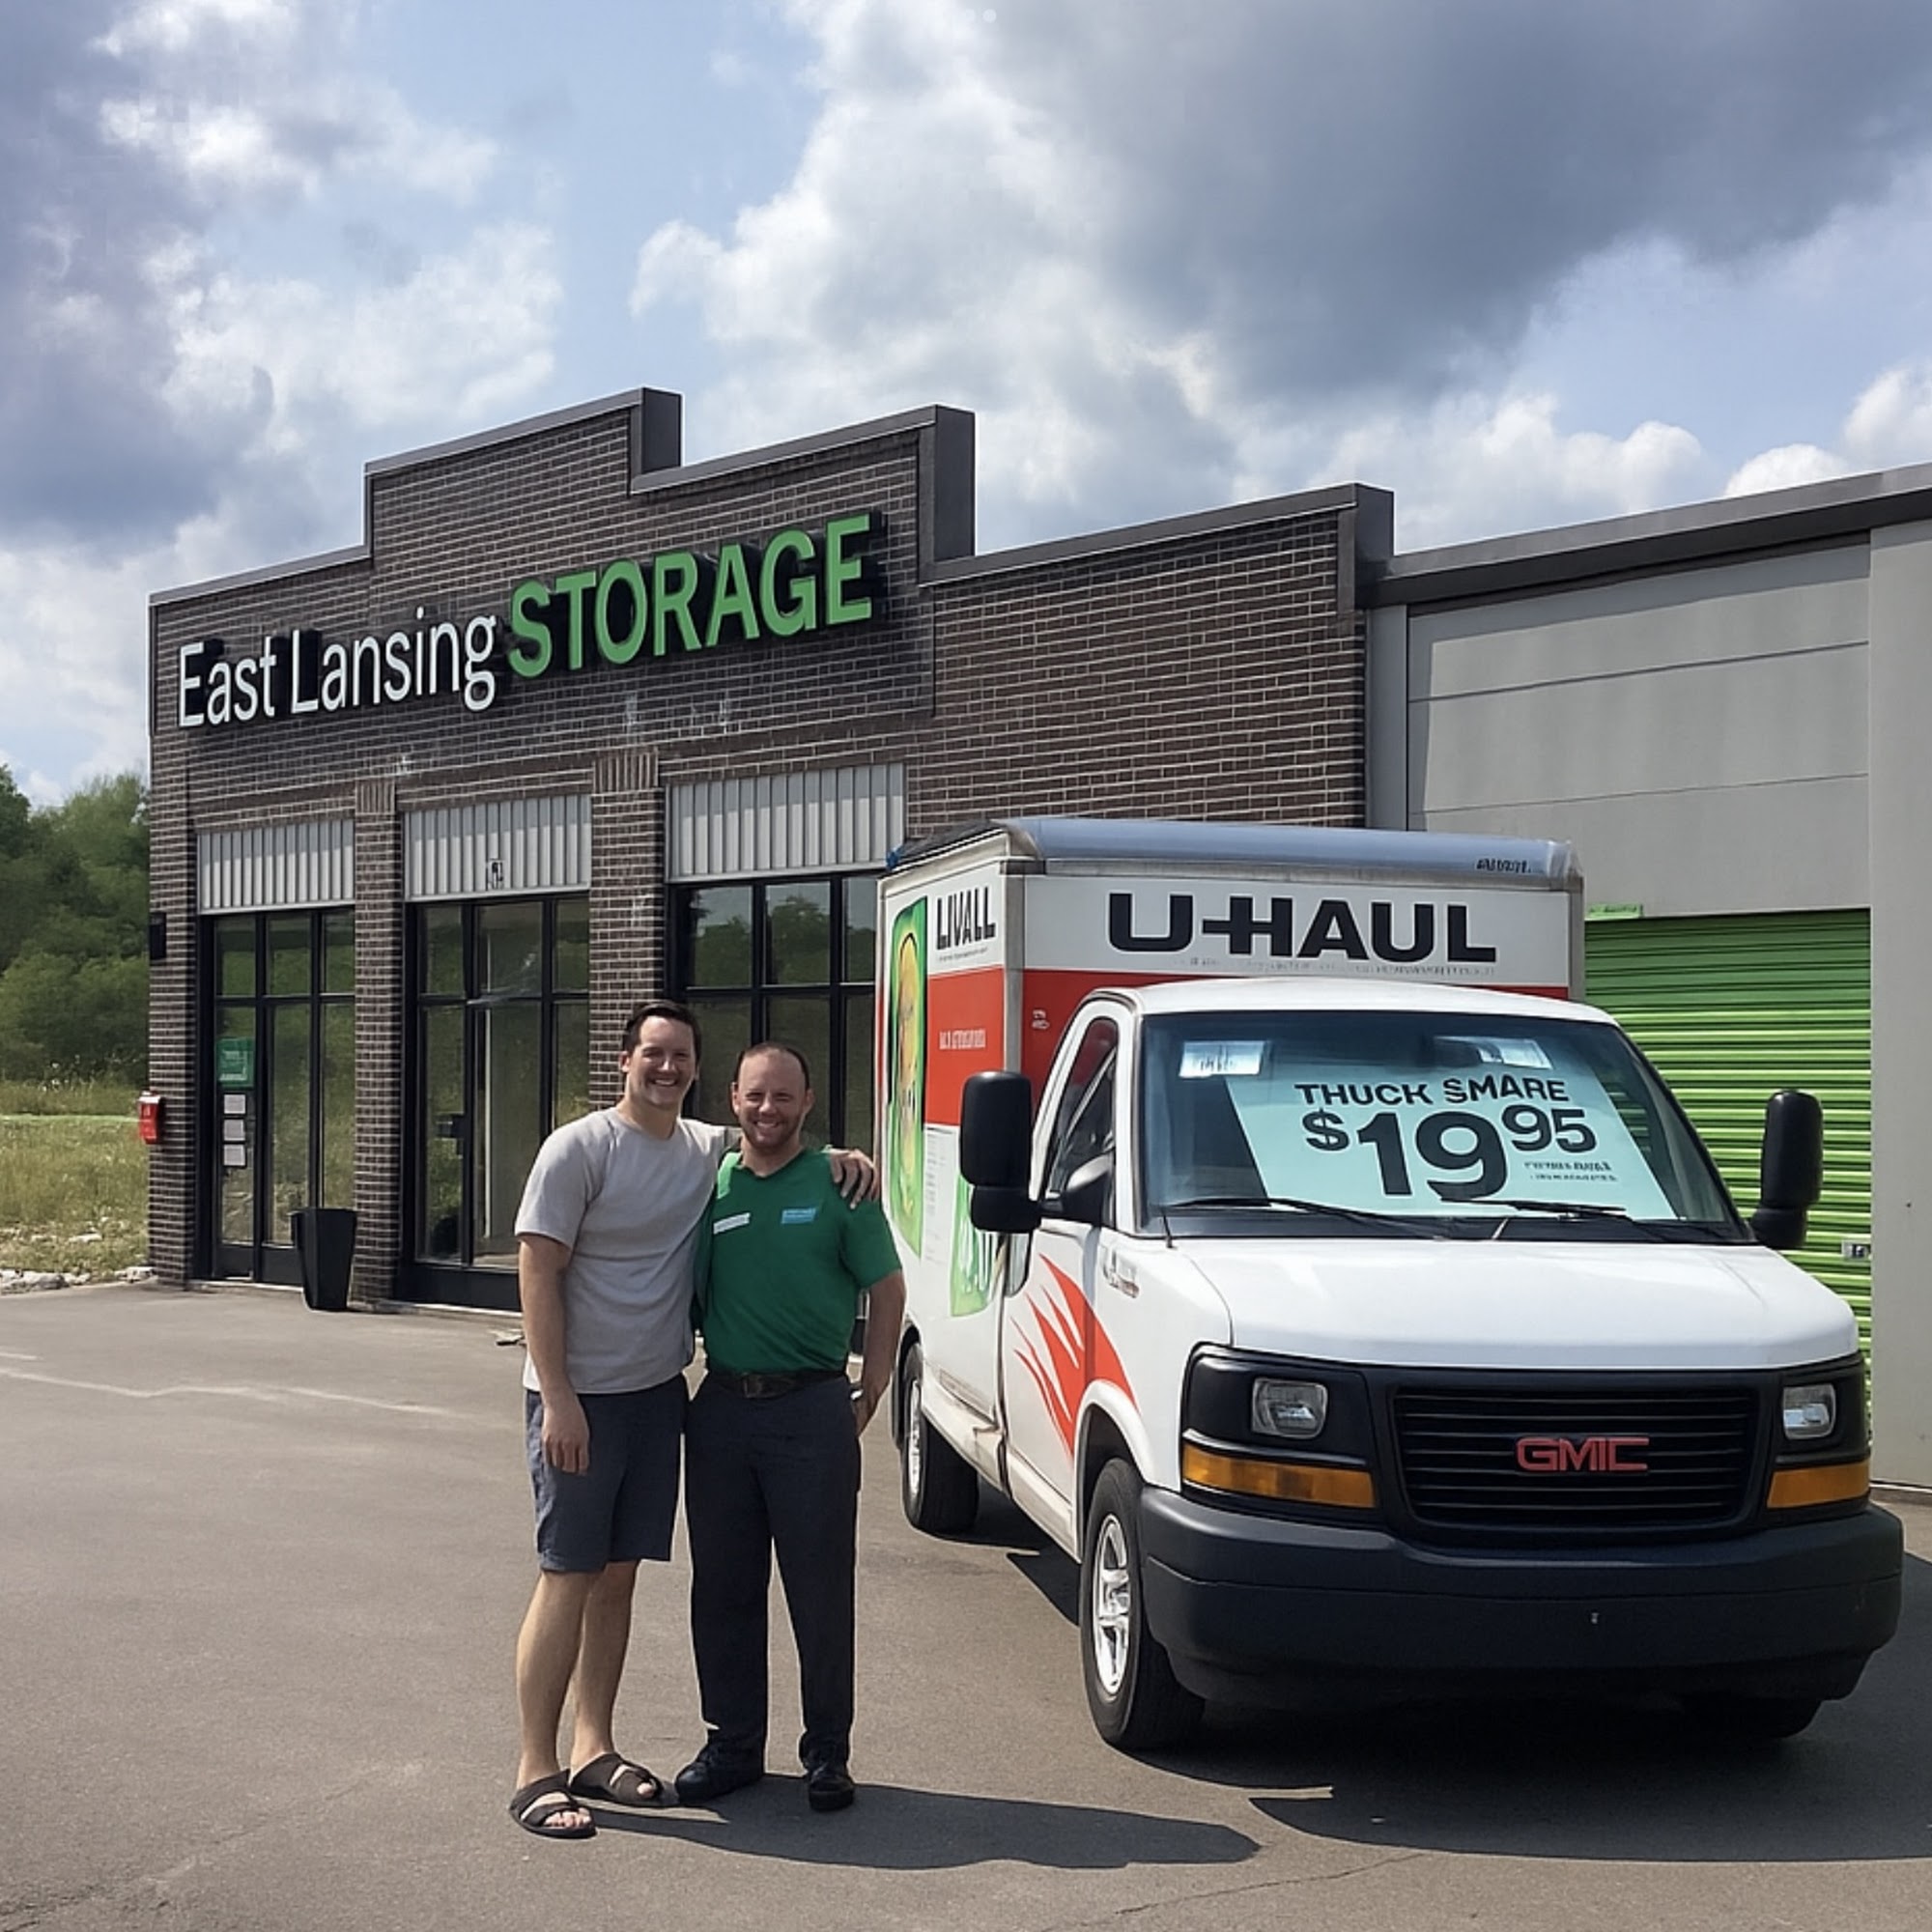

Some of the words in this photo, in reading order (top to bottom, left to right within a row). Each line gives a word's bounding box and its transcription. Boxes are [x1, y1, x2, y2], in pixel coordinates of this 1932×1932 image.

[179, 635, 277, 726] East
[291, 606, 497, 713] Lansing
[507, 513, 873, 679] STORAGE
[1108, 892, 1497, 964] U-HAUL
